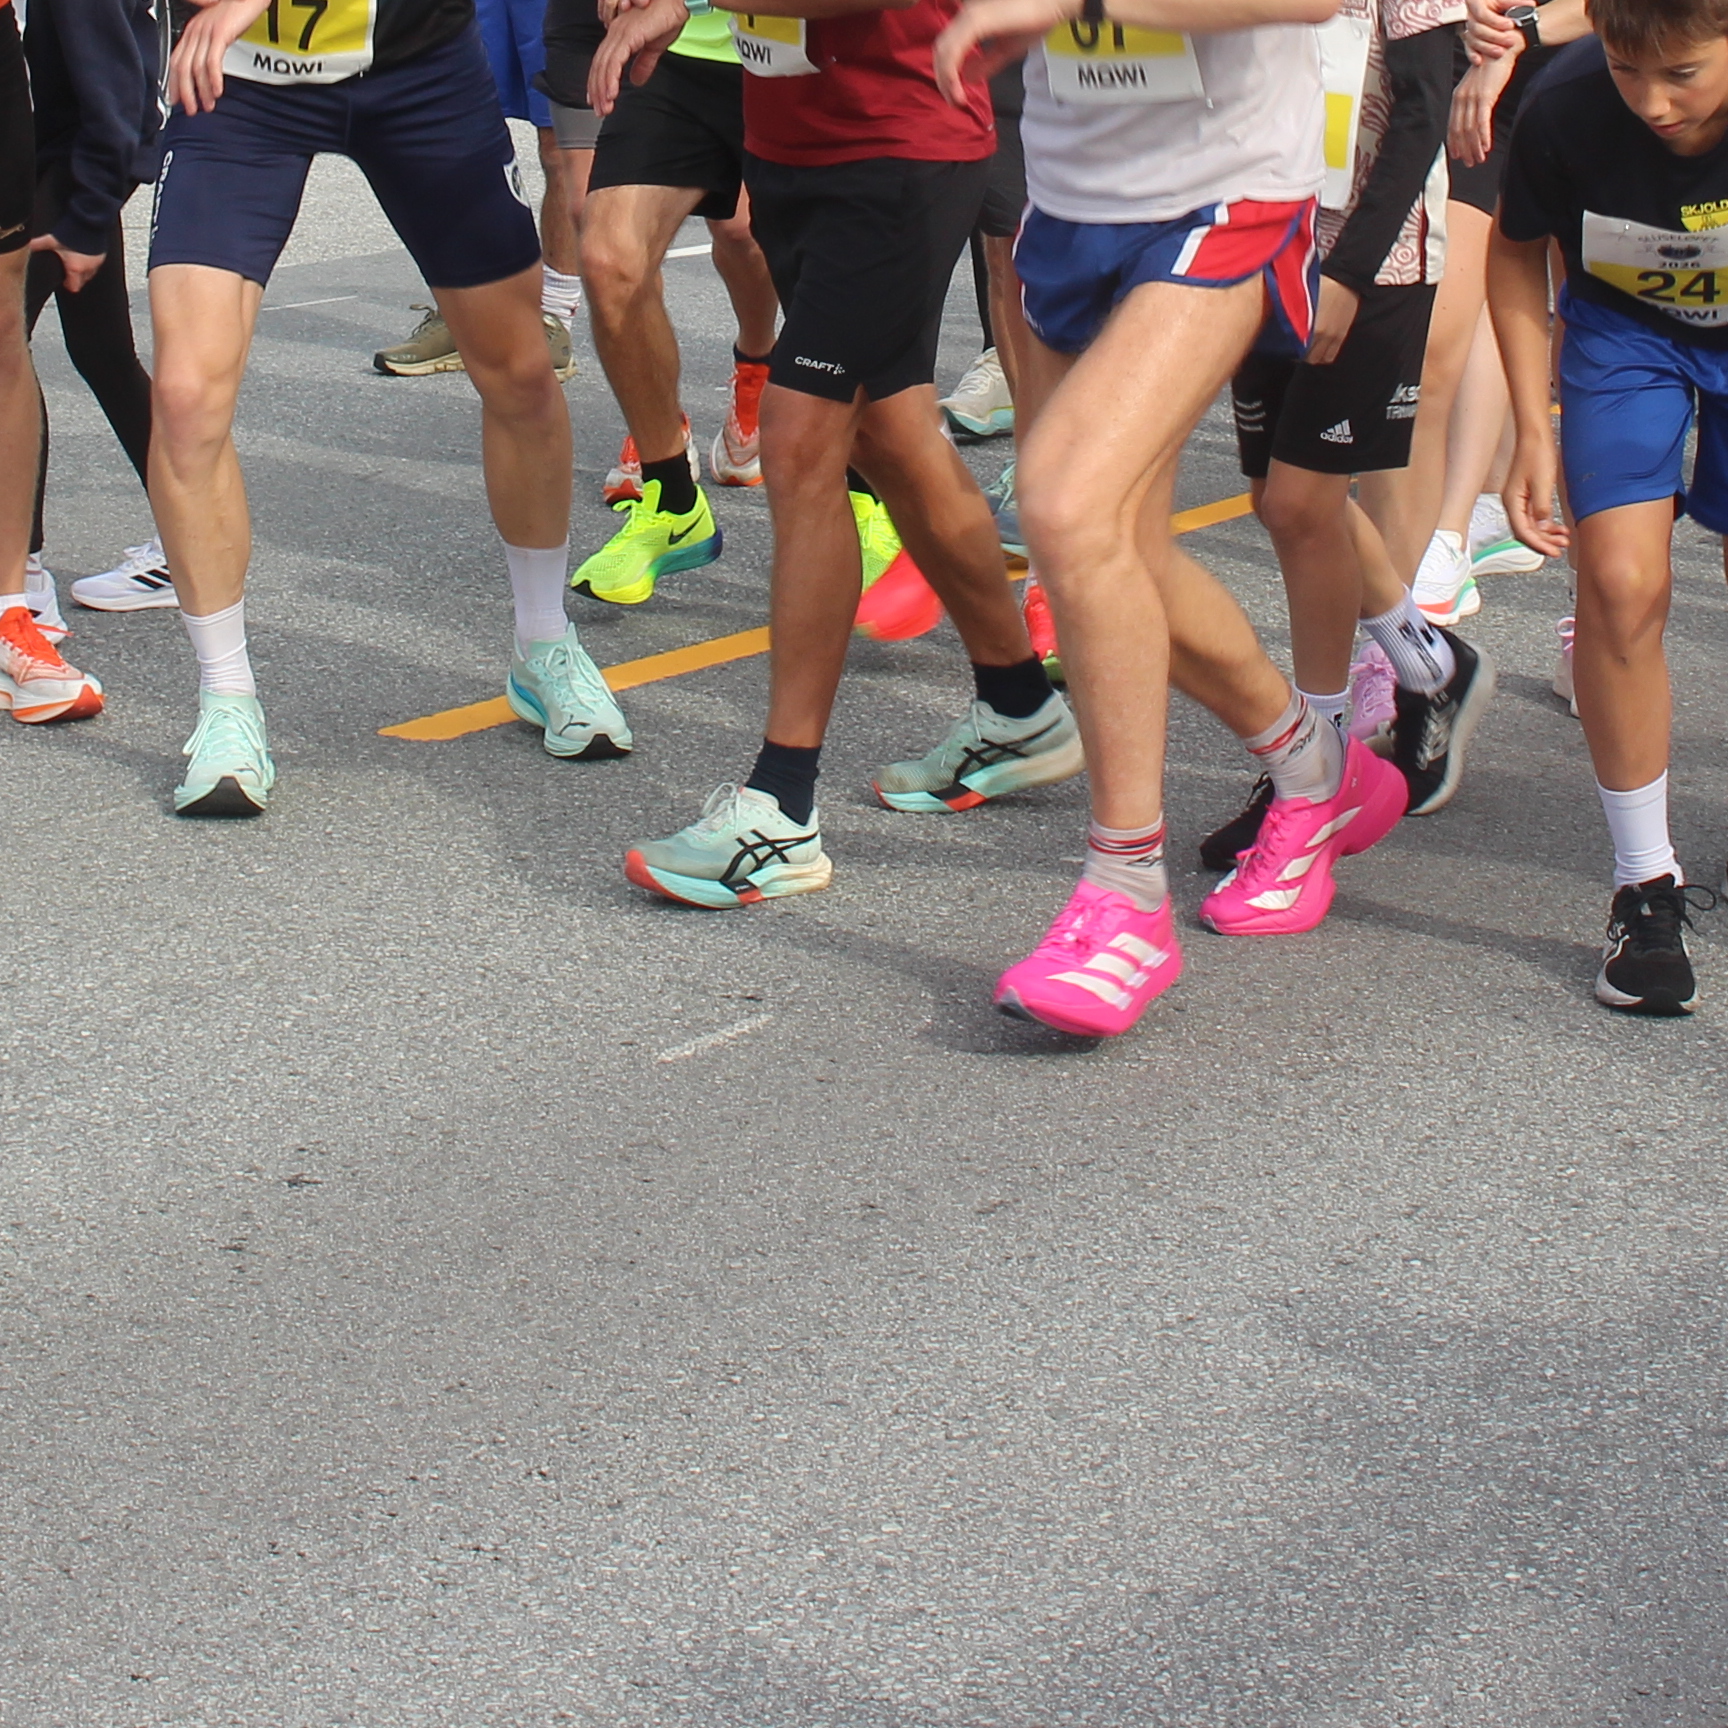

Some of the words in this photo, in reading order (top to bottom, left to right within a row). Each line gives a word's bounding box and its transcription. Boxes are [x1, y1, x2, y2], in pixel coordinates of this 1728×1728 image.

[1657, 261, 1702, 270] 2026
[1636, 270, 1721, 304] 24
[794, 355, 835, 373] CRAFT
